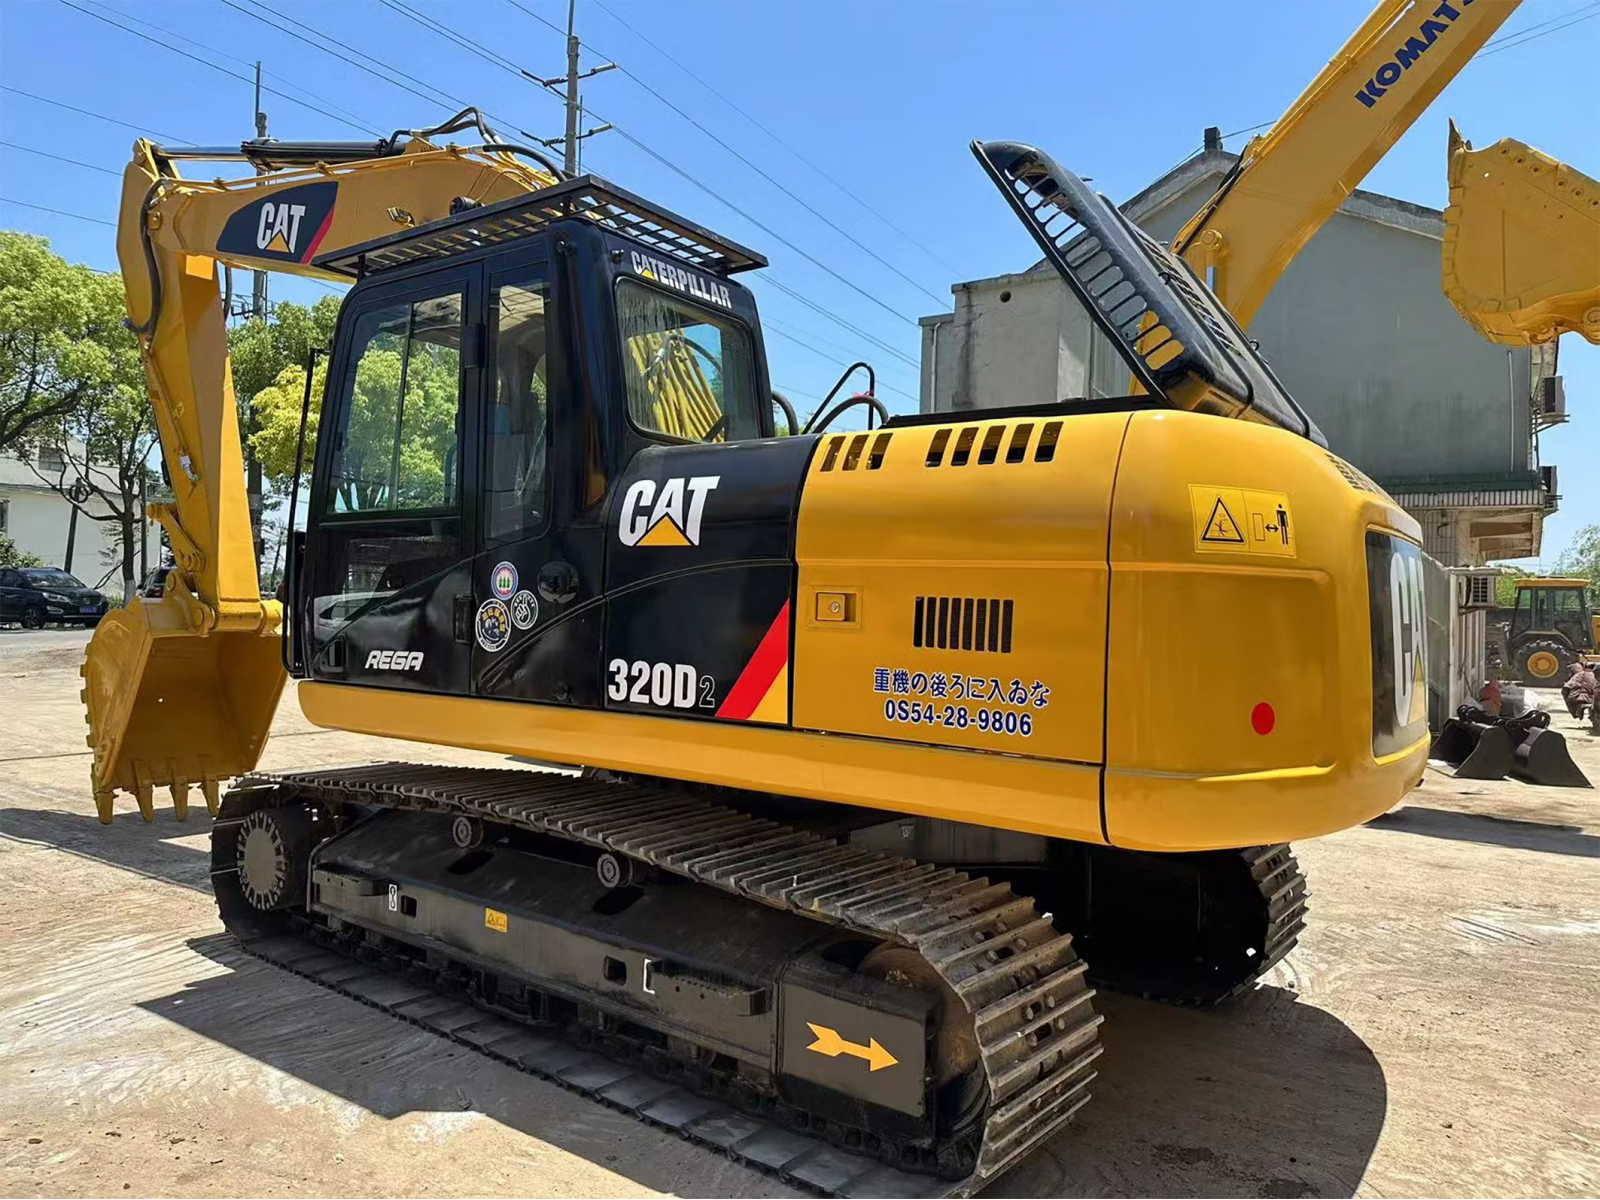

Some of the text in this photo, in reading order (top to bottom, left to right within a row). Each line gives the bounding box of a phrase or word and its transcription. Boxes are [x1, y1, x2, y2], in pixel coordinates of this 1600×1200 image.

[1354, 0, 1475, 109] KOMAT
[256, 202, 306, 254] CAT
[630, 250, 732, 309] CATERPILLAR
[618, 476, 721, 547] CAT
[364, 650, 424, 671] REGA
